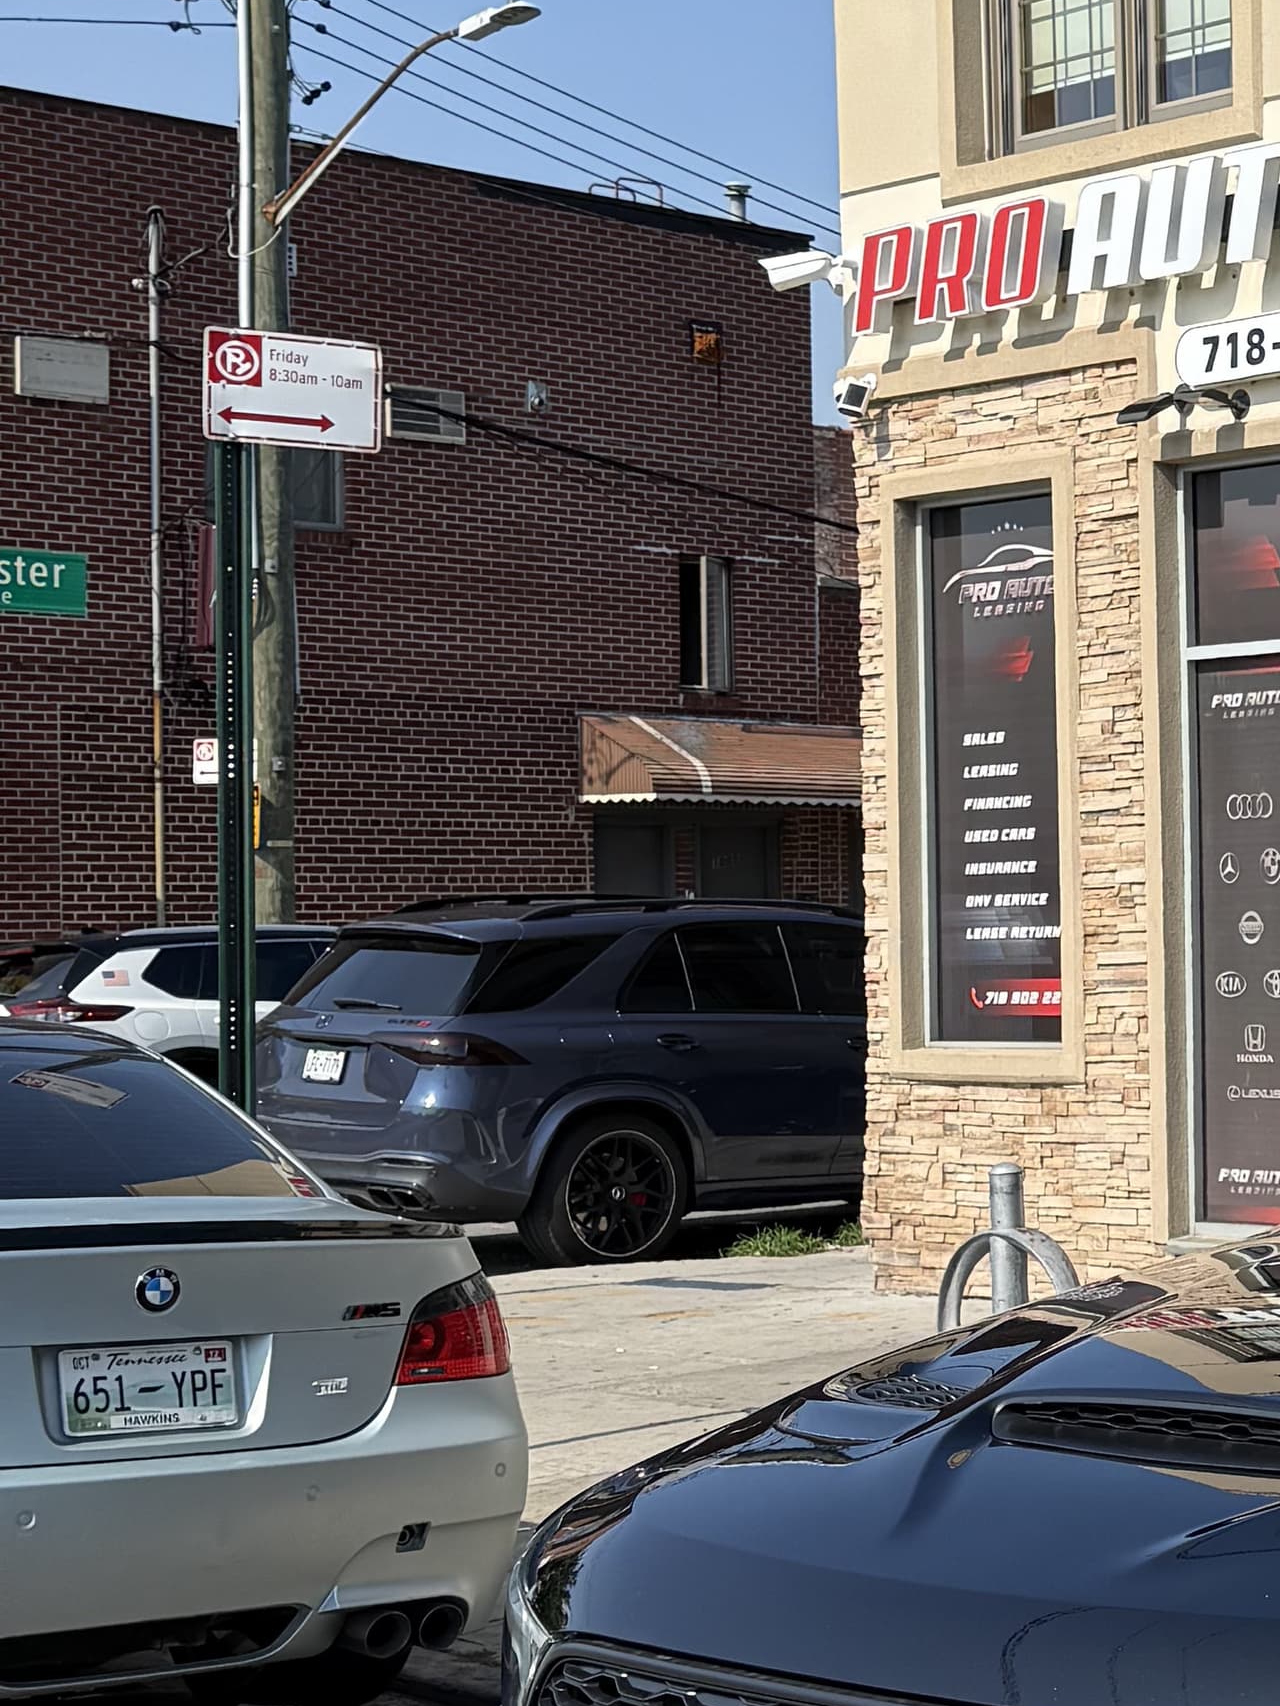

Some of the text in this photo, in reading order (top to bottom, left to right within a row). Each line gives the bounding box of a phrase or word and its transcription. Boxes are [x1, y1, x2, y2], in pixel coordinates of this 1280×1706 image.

[853, 195, 1062, 335] PRO
[270, 349, 309, 367] Friday
[269, 369, 318, 385] 8:30am
[331, 375, 363, 390] 10am
[958, 580, 1001, 604] PRO
[973, 600, 1045, 618] LEASING
[1211, 692, 1243, 708] PRO
[962, 731, 1005, 746] SALES
[963, 763, 1019, 778] LEASING
[964, 795, 1032, 811] FINANCING
[964, 827, 1036, 843] USED CARS
[965, 860, 1037, 875] INSURANCE
[965, 892, 1048, 908] DMV SERVICE
[966, 926, 1008, 940] LEASE
[1220, 976, 1241, 992] KIA
[984, 991, 1008, 1005] 718
[1236, 1053, 1274, 1063] HONDA
[1218, 1168, 1250, 1183] PRO
[106, 1351, 189, 1370] Tennessee
[74, 1369, 227, 1414] 651 YPF
[123, 1413, 180, 1426] HAWKINS
